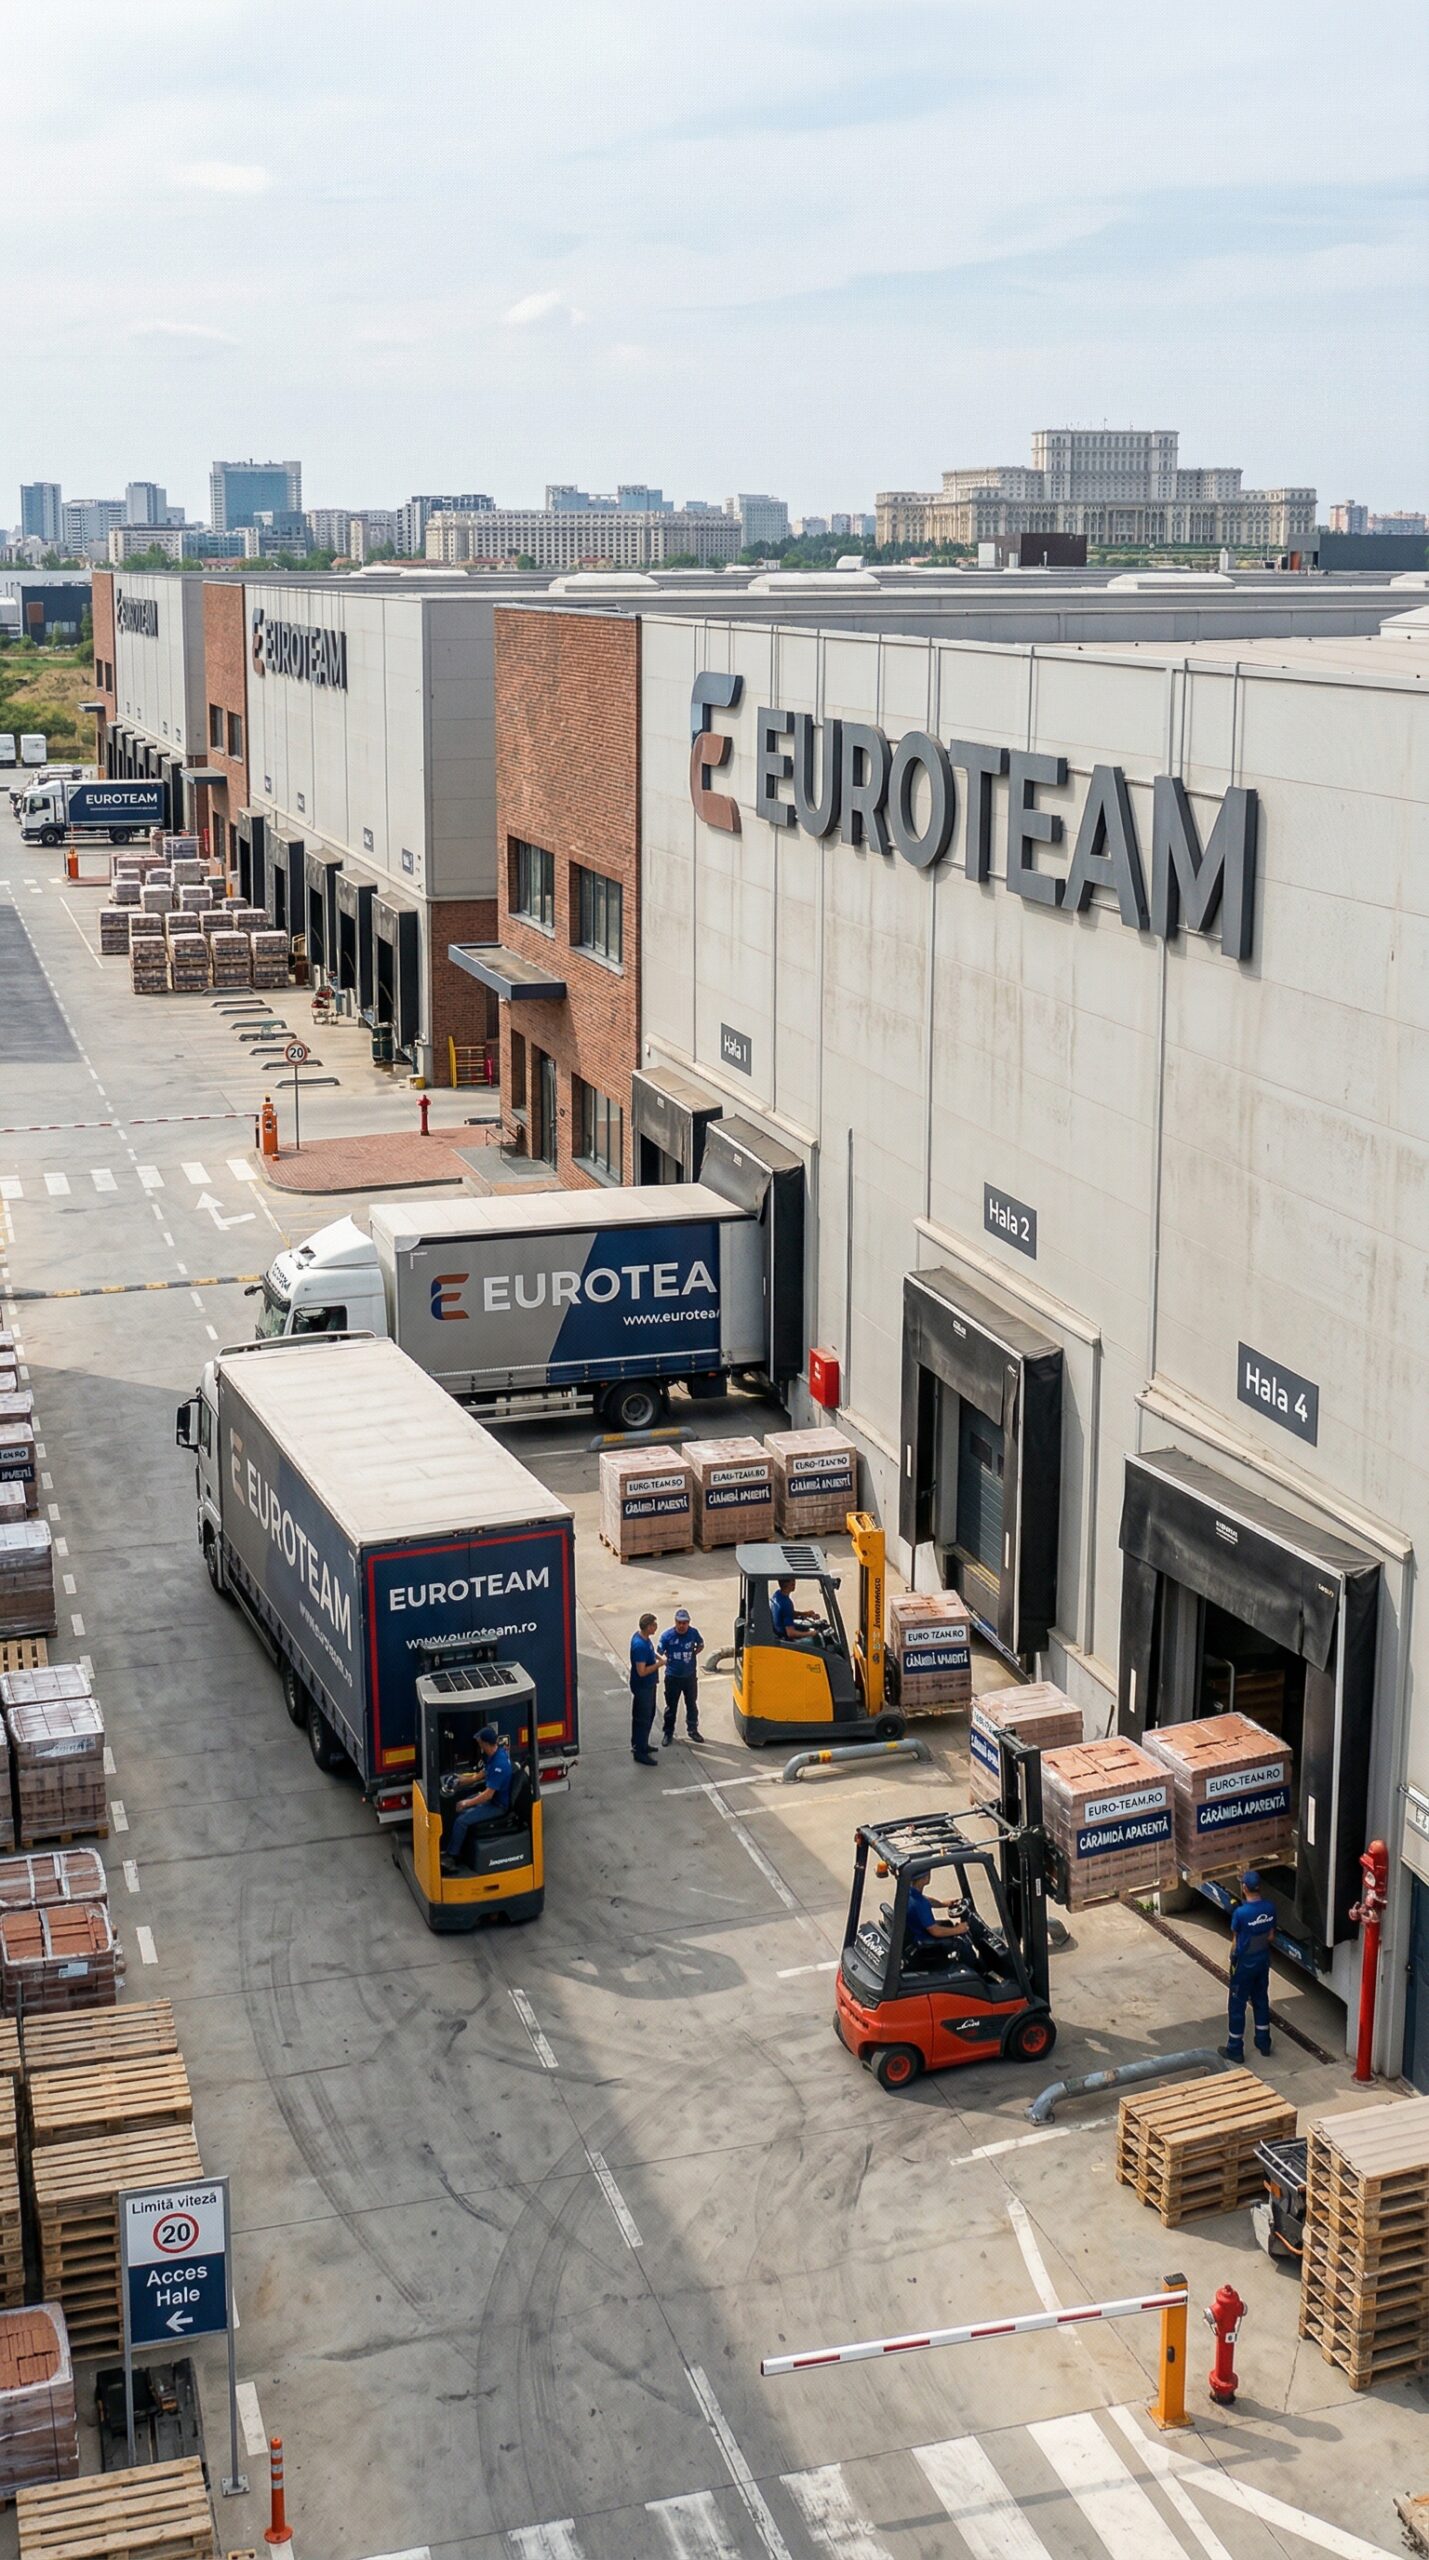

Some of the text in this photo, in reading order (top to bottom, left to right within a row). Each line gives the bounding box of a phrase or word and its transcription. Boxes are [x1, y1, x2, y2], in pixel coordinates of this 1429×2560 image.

[266, 619, 347, 692] EUROTEAM
[86, 793, 157, 805] EUROTEAM
[756, 706, 1257, 960] EUROTEAM
[290, 1047, 304, 1058] 20
[989, 1198, 1030, 1242] Hala 2
[483, 1260, 718, 1312] EUROTEA
[1246, 1362, 1308, 1423] Hala 4
[247, 1458, 352, 1652] EUROTEAM
[389, 1567, 549, 1611] EUROTEAM
[1088, 1792, 1163, 1817] EURO-TEAM.RO
[162, 2223, 191, 2244] 20
[146, 2265, 208, 2288] Acces
[156, 2286, 200, 2307] Hale
